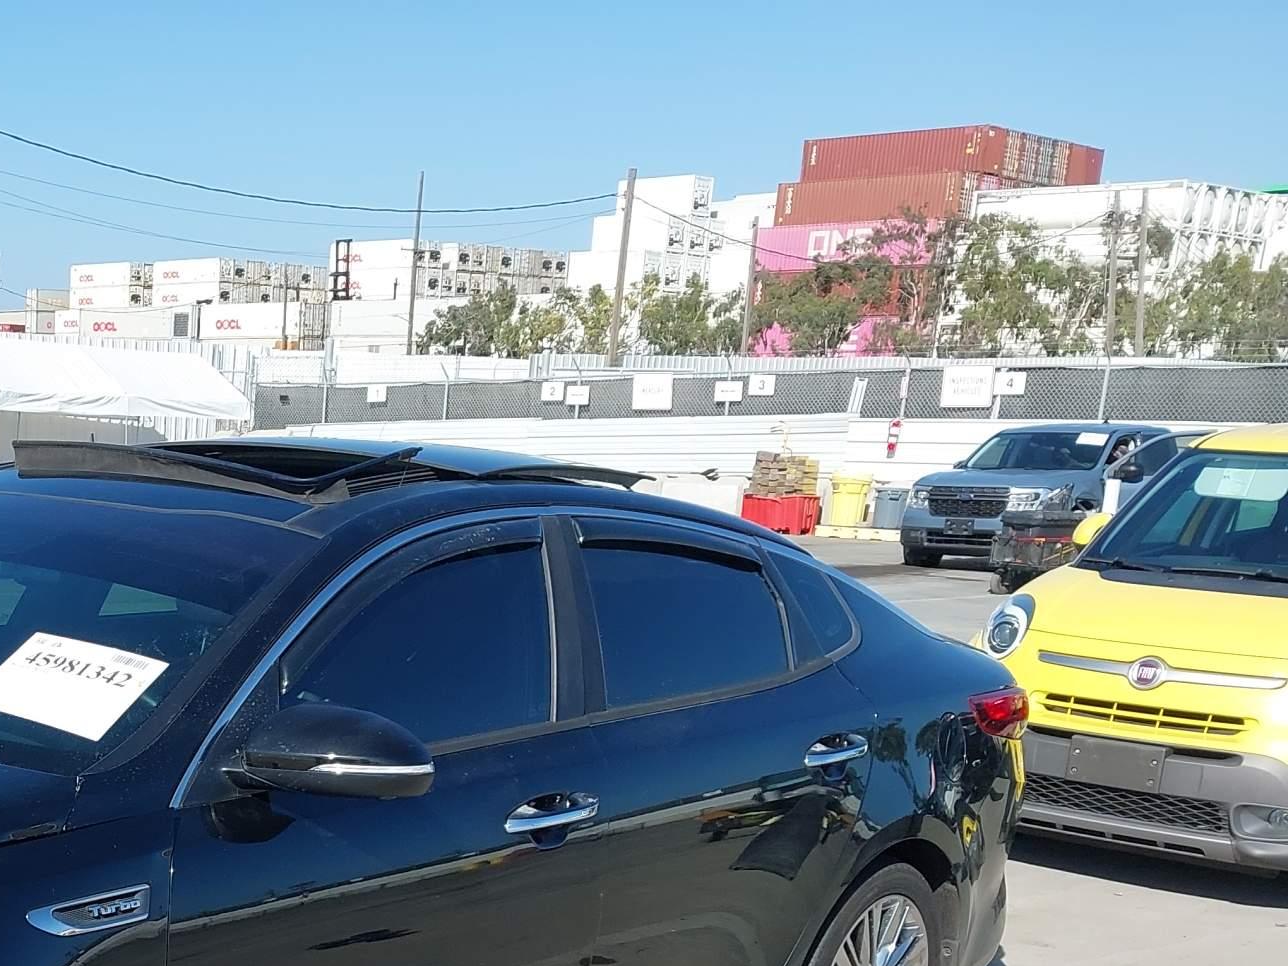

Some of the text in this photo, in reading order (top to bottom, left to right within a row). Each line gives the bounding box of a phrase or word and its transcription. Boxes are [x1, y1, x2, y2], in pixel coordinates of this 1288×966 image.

[79, 274, 94, 283] OOCL
[163, 271, 180, 279] OOCL
[78, 297, 94, 306] OOCL
[63, 319, 79, 328] OOCL
[93, 321, 118, 332] OOCL
[215, 319, 242, 330] OOCL
[758, 379, 766, 390] 3
[1006, 378, 1014, 388] 4
[549, 386, 556, 396] 2
[24, 650, 133, 689] 45981342
[88, 899, 141, 917] Turbo
